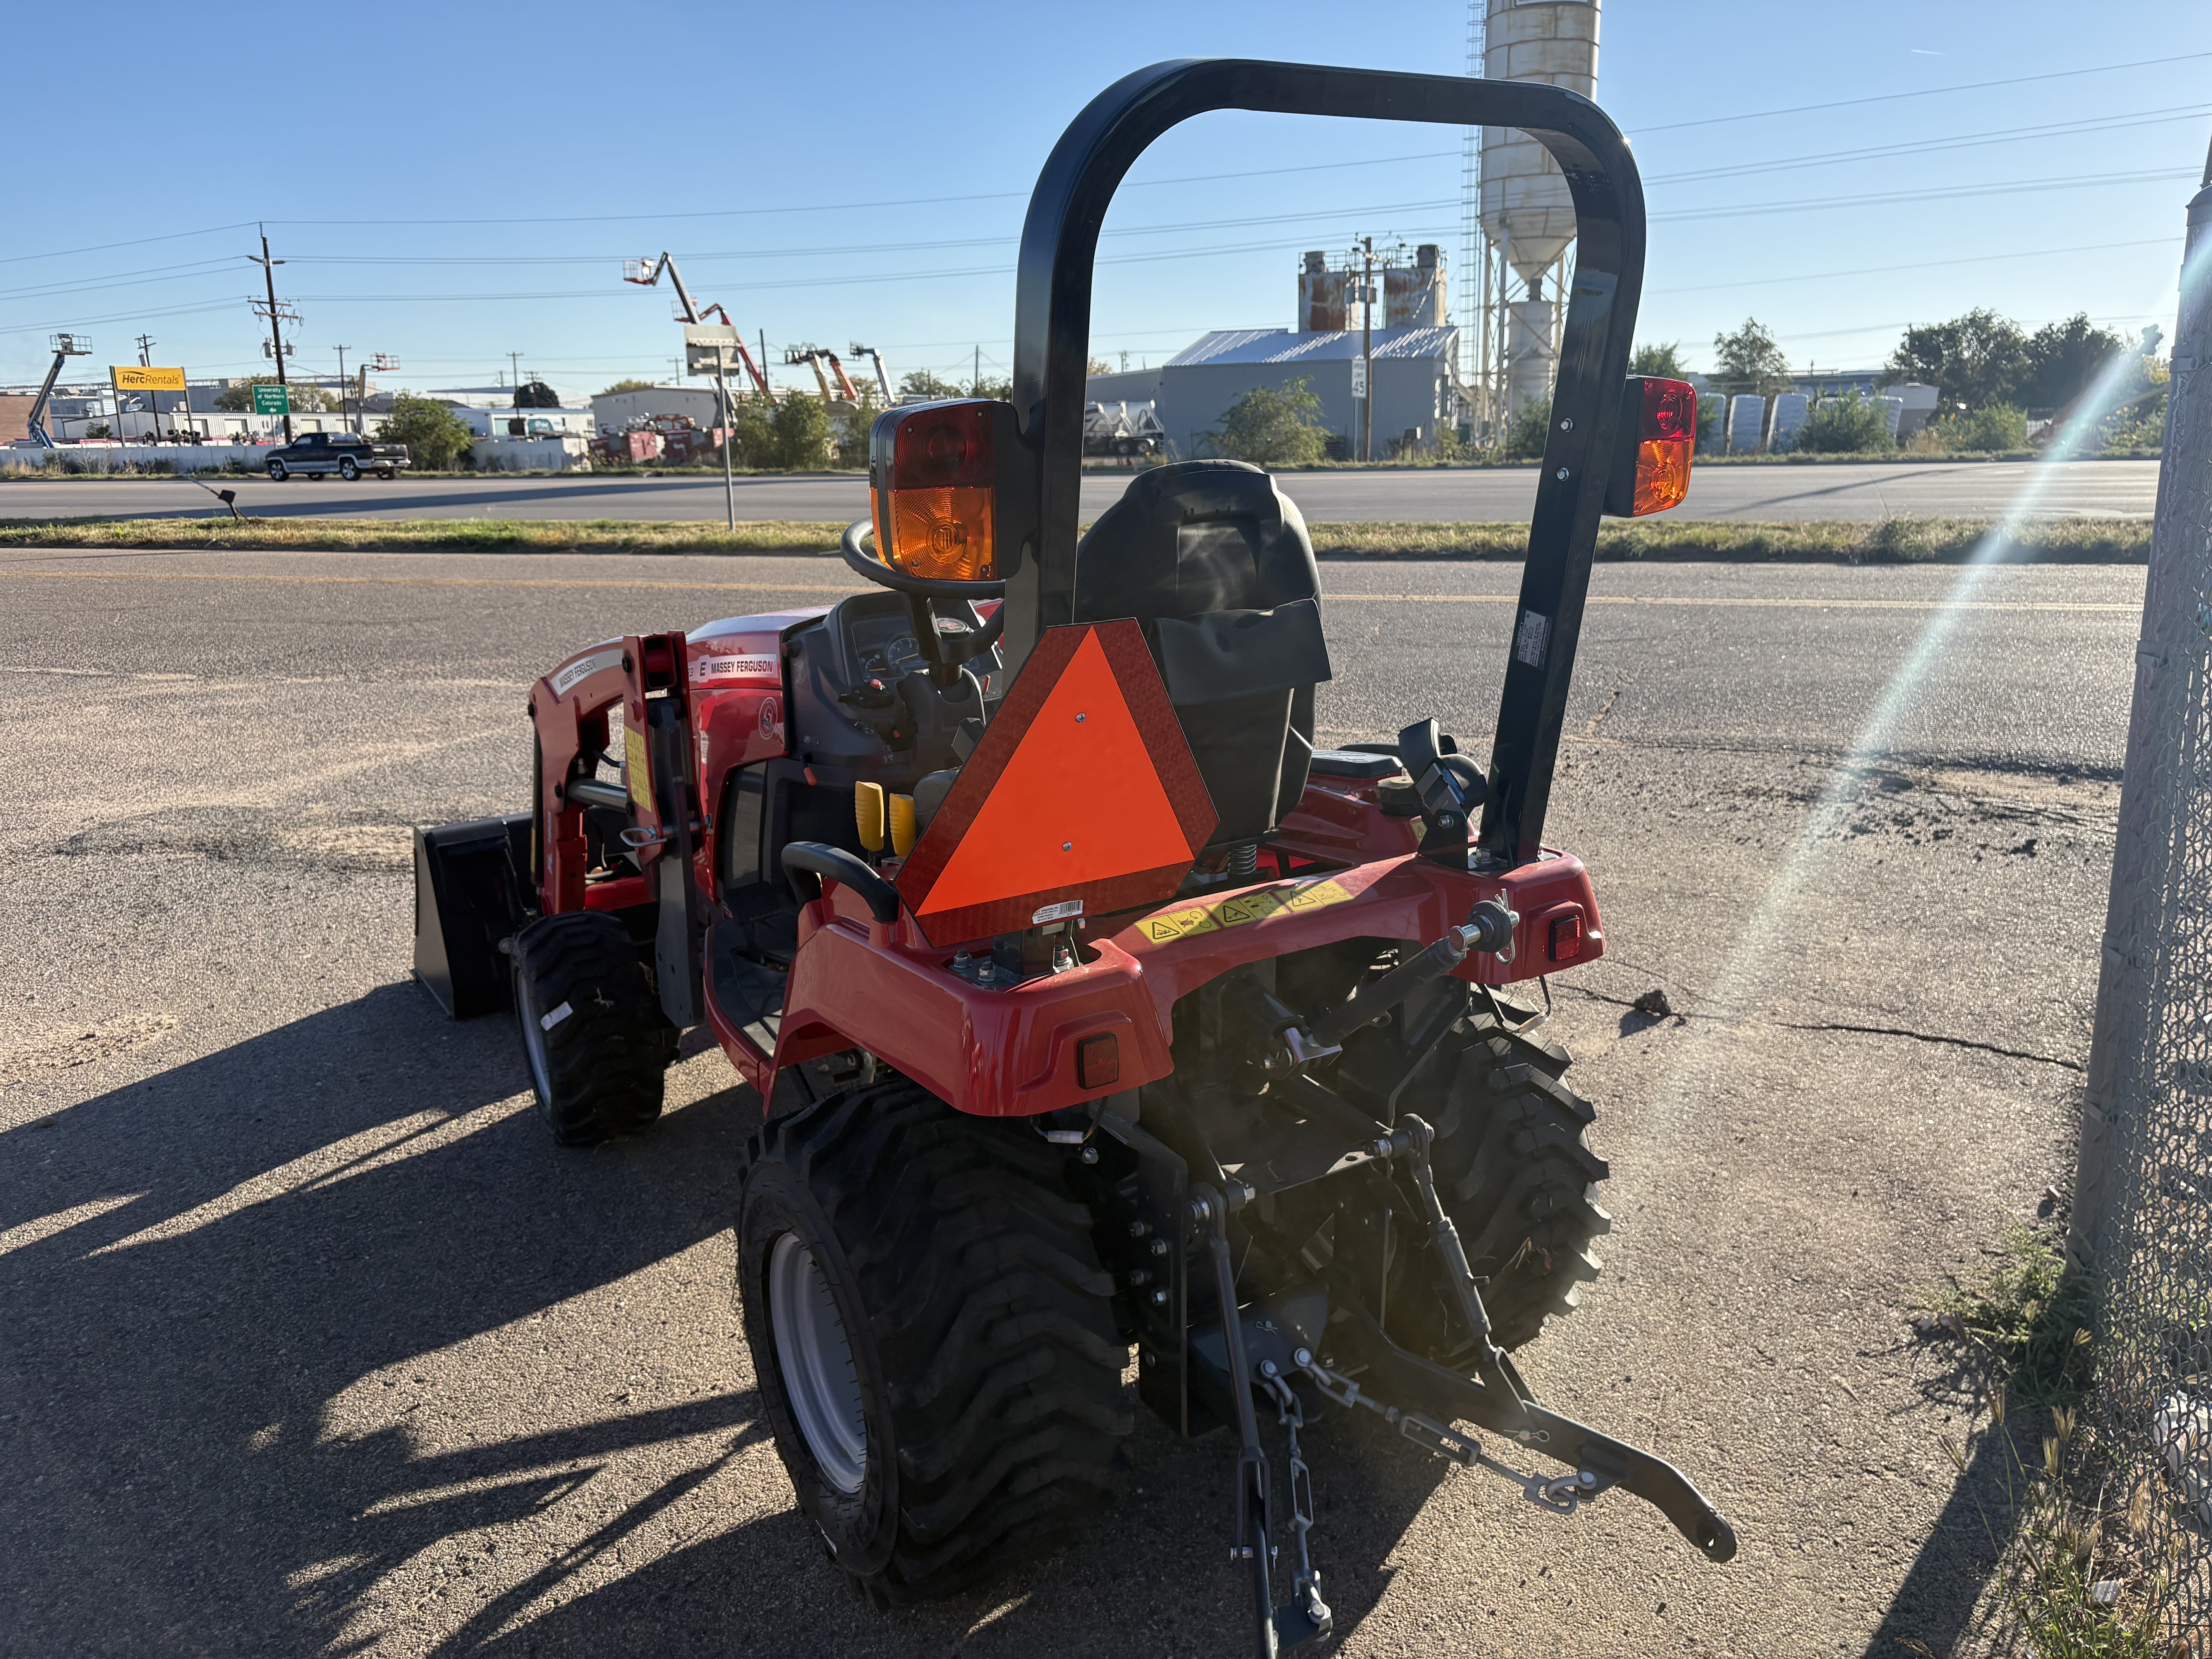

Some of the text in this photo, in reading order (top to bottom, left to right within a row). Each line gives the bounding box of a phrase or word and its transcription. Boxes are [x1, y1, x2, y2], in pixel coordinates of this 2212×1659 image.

[1353, 381, 1364, 393] 45
[559, 658, 596, 688] MASSEY FERGUSON
[700, 662, 706, 676] E
[711, 661, 735, 674] MASSEY
[737, 660, 773, 673] FERGUSON
